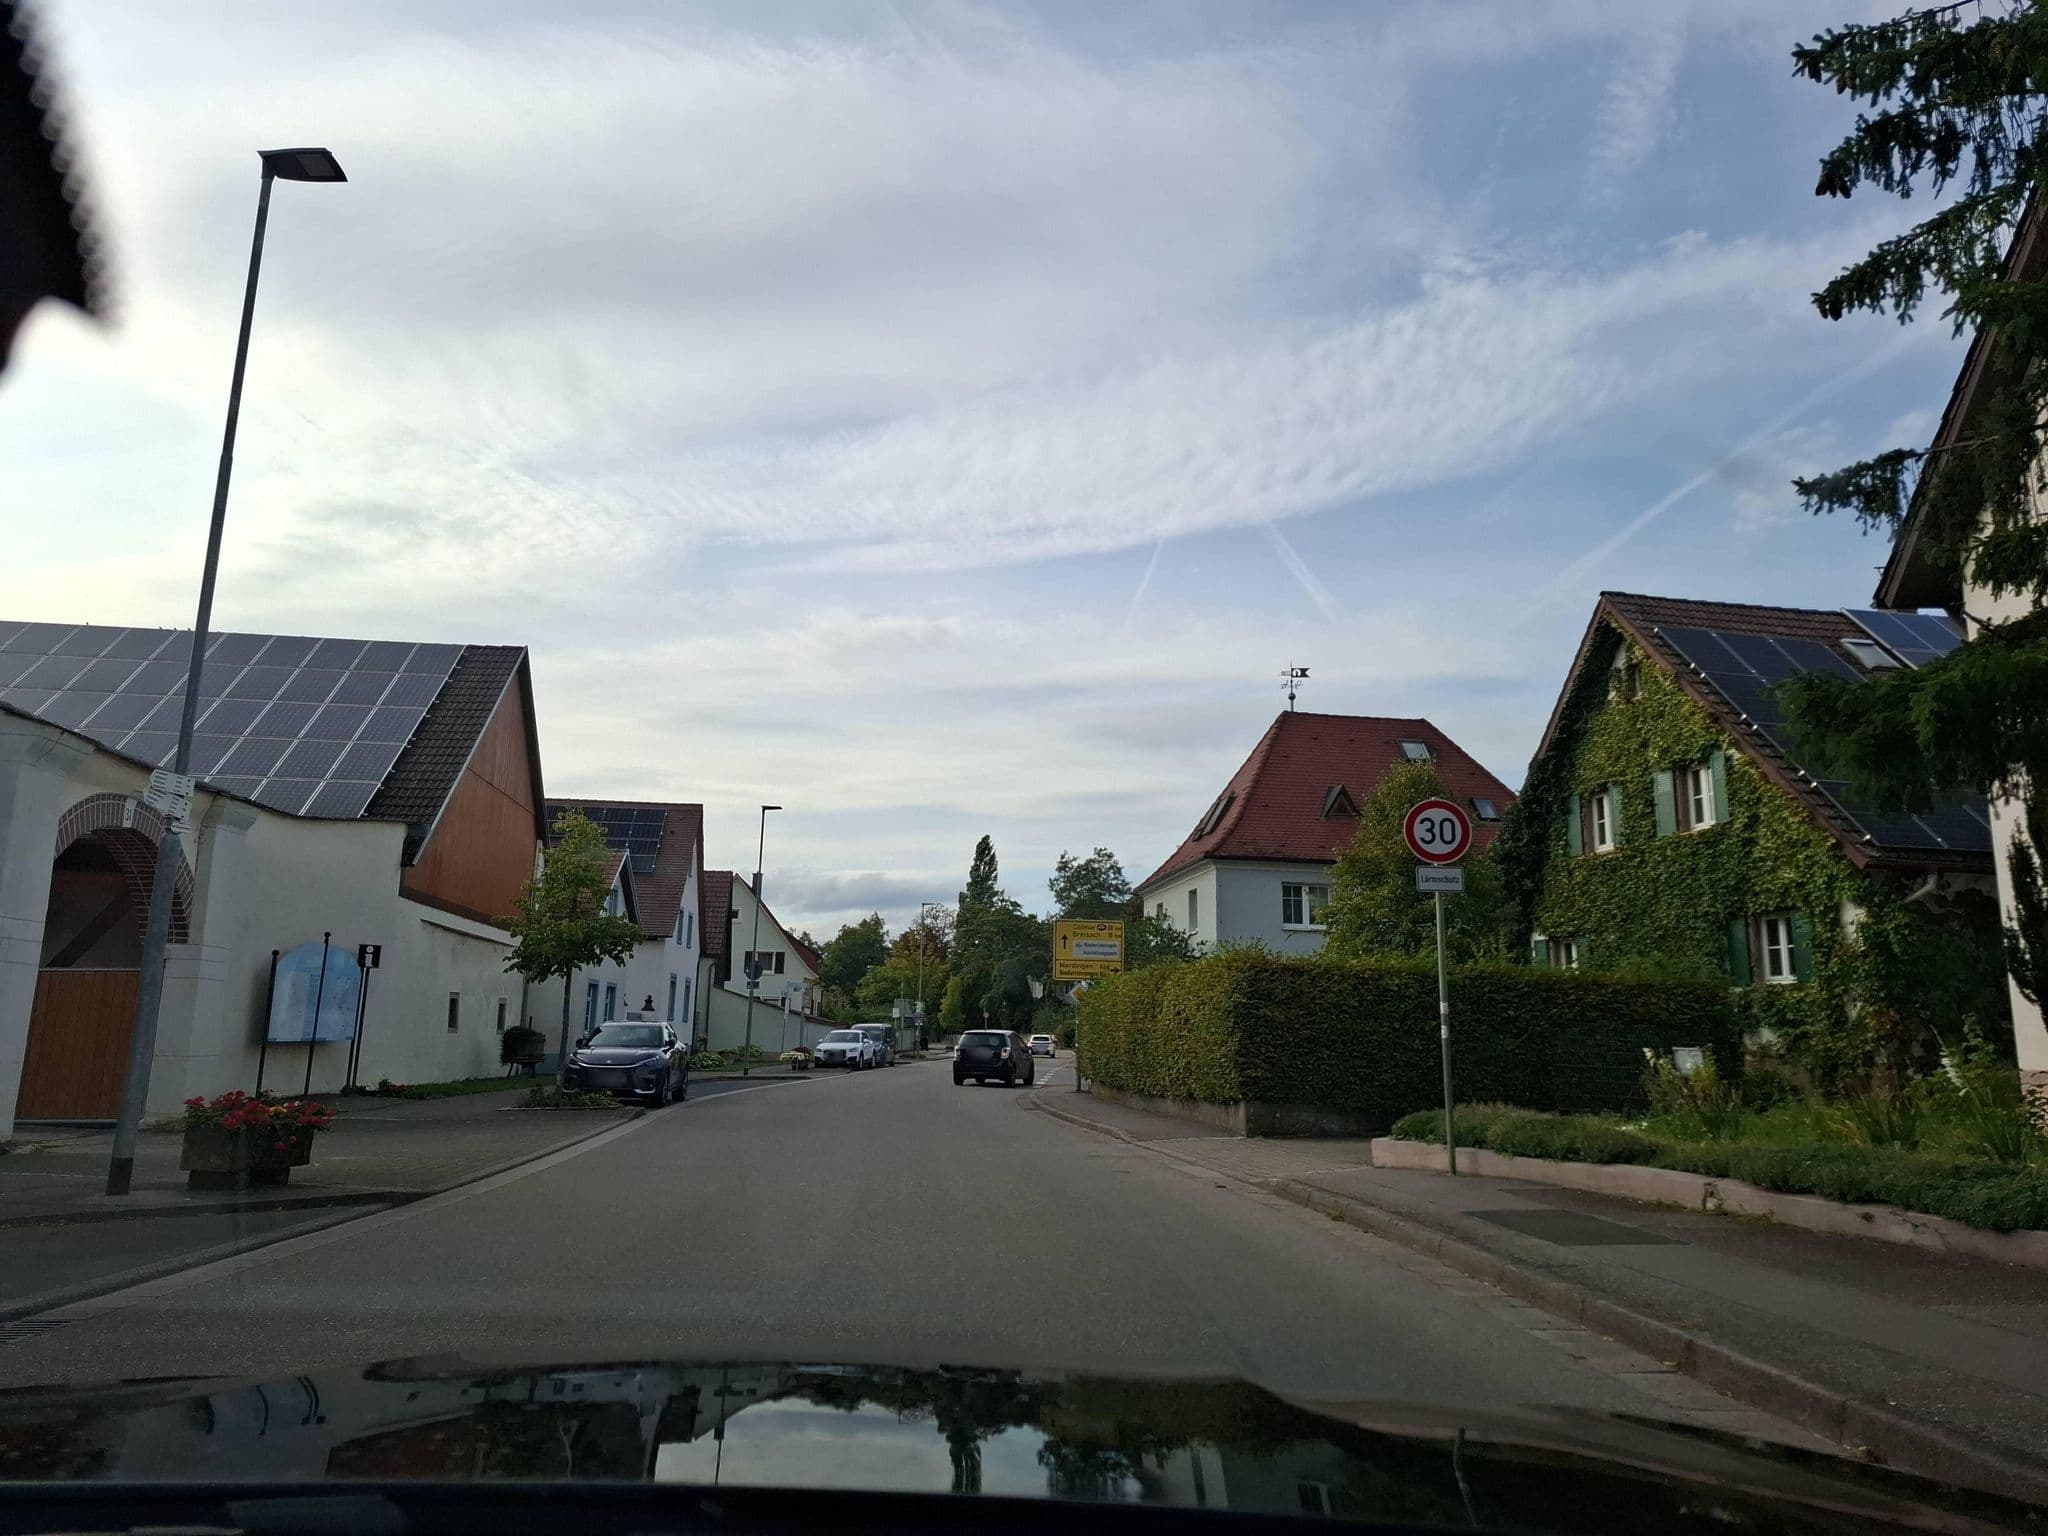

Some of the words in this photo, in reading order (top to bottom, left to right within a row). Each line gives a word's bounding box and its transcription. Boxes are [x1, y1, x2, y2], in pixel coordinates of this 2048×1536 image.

[125, 808, 132, 821] 31
[1419, 817, 1456, 845] 30
[1420, 874, 1459, 883] Lärmschutz
